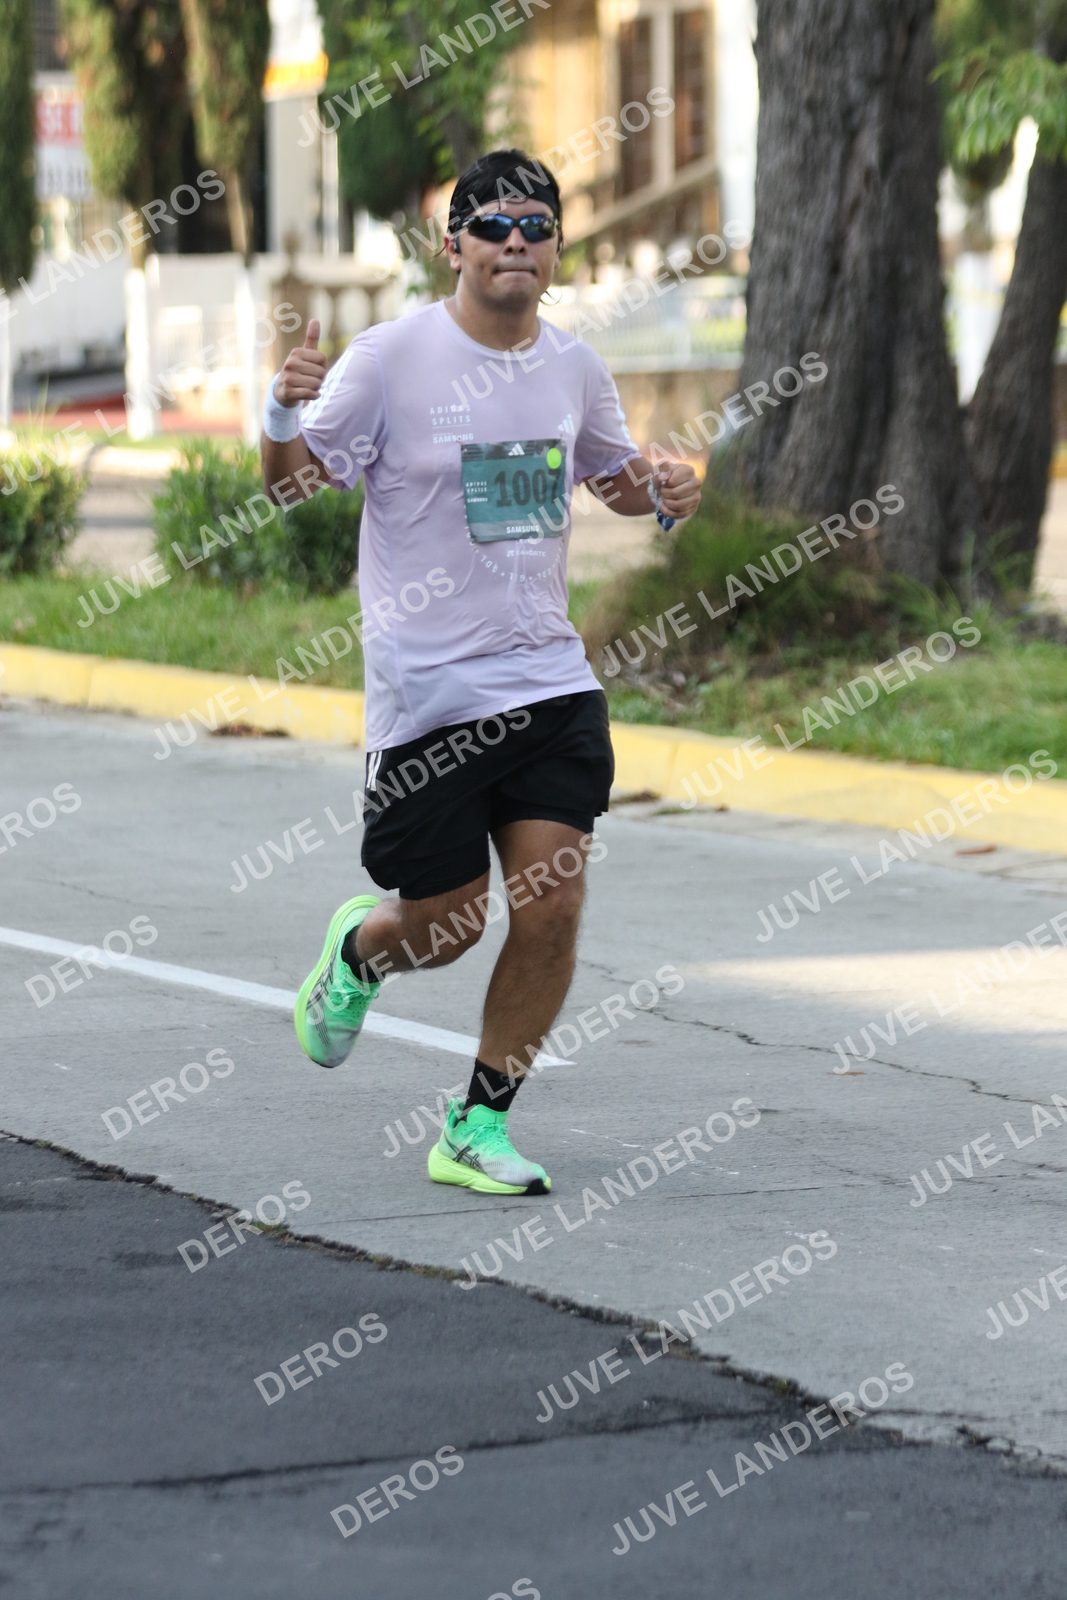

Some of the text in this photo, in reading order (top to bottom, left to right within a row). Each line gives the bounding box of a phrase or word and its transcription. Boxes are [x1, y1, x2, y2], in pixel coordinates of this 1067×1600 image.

[431, 415, 471, 426] SPLITS
[494, 468, 562, 508] 1007
[506, 524, 539, 534] SAMSUNG
